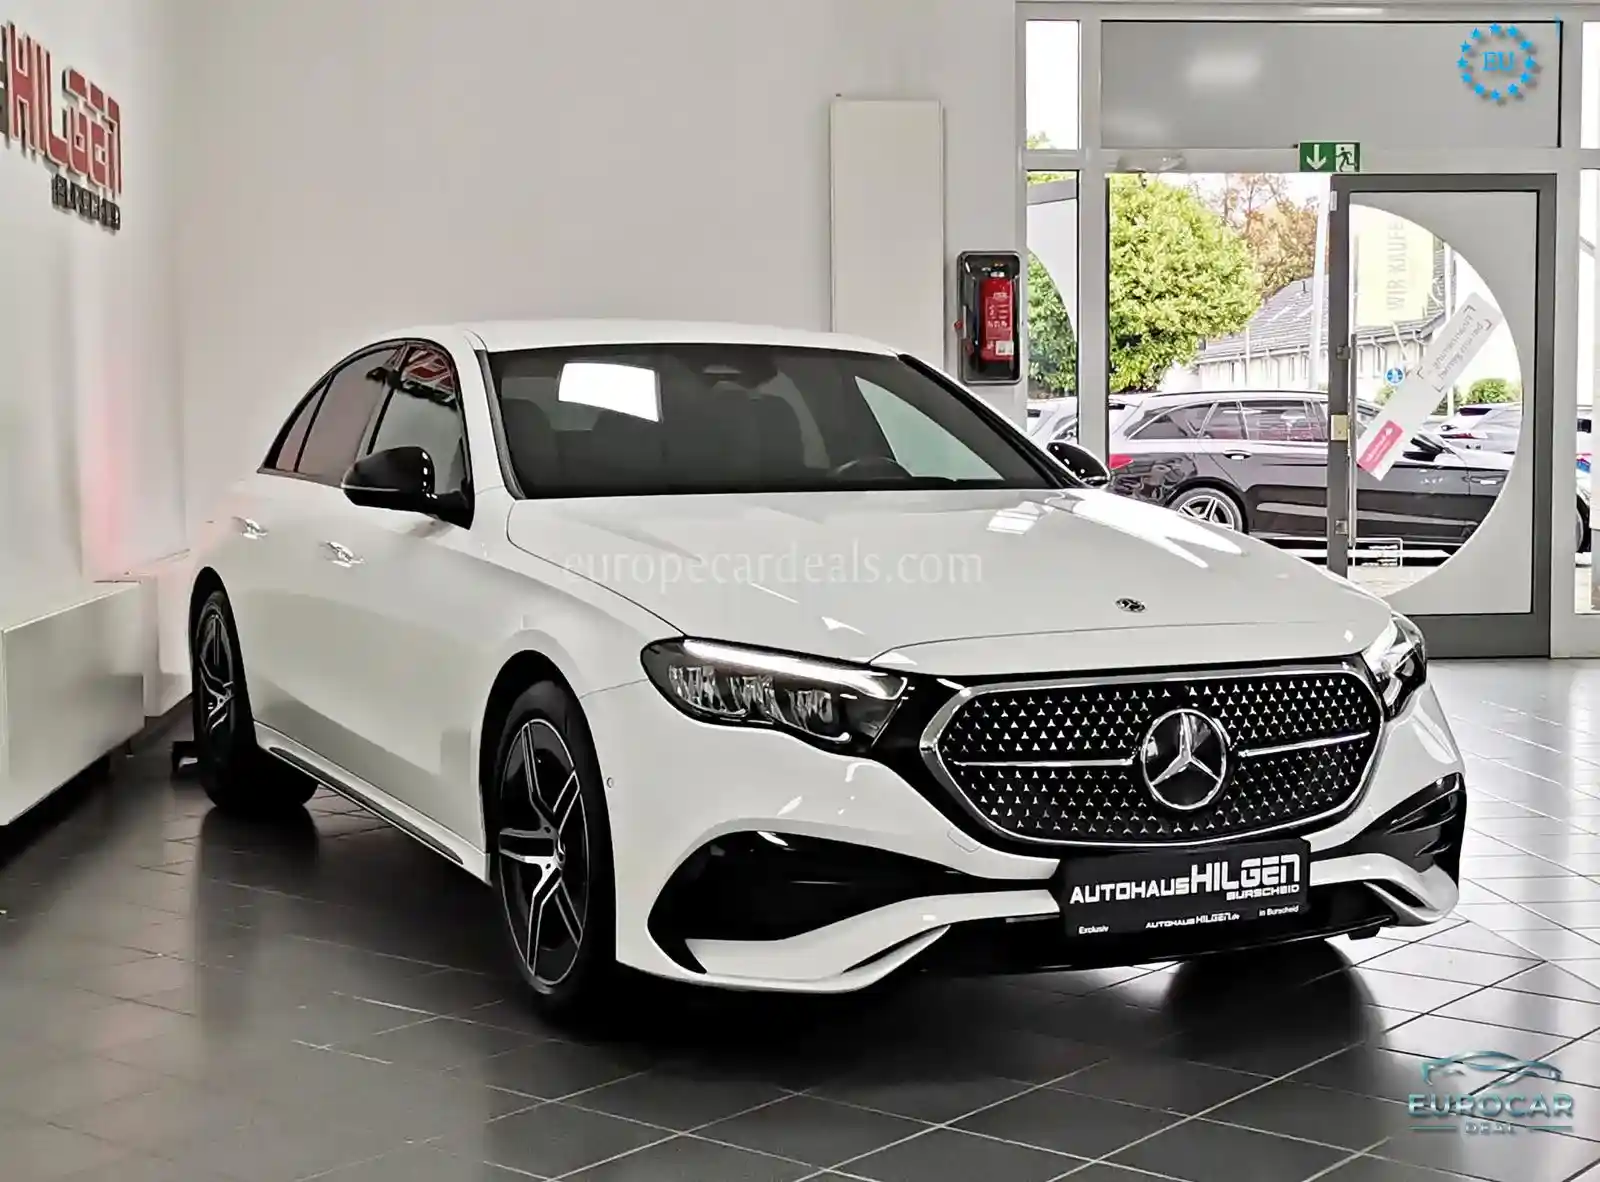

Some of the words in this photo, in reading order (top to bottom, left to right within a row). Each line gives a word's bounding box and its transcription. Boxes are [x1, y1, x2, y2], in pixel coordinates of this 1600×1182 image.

[0, 20, 121, 198] HILGEN
[1226, 884, 1300, 901] BURSCHEID
[1267, 906, 1299, 916] Burscheid
